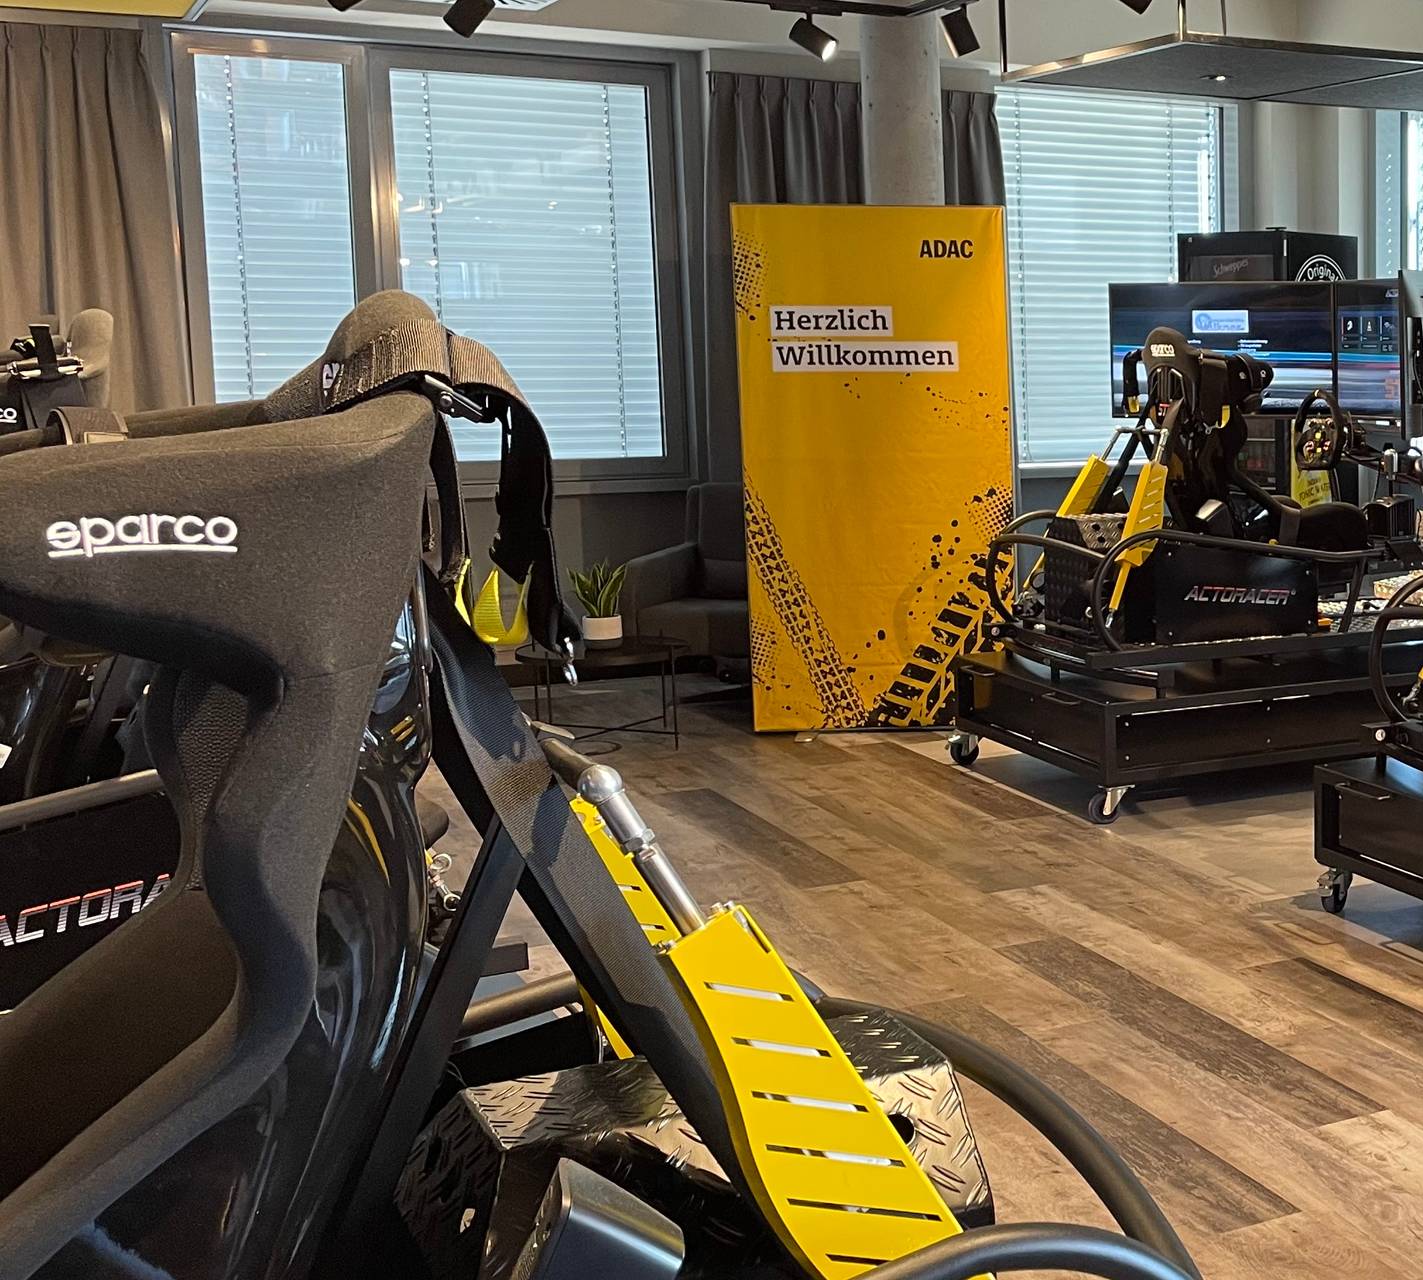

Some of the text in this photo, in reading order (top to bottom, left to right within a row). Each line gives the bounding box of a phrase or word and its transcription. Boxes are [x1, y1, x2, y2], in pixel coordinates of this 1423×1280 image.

[919, 239, 974, 259] ADAC
[774, 309, 889, 331] Herzlich
[776, 344, 954, 366] Willkommen
[46, 513, 238, 558] sparco
